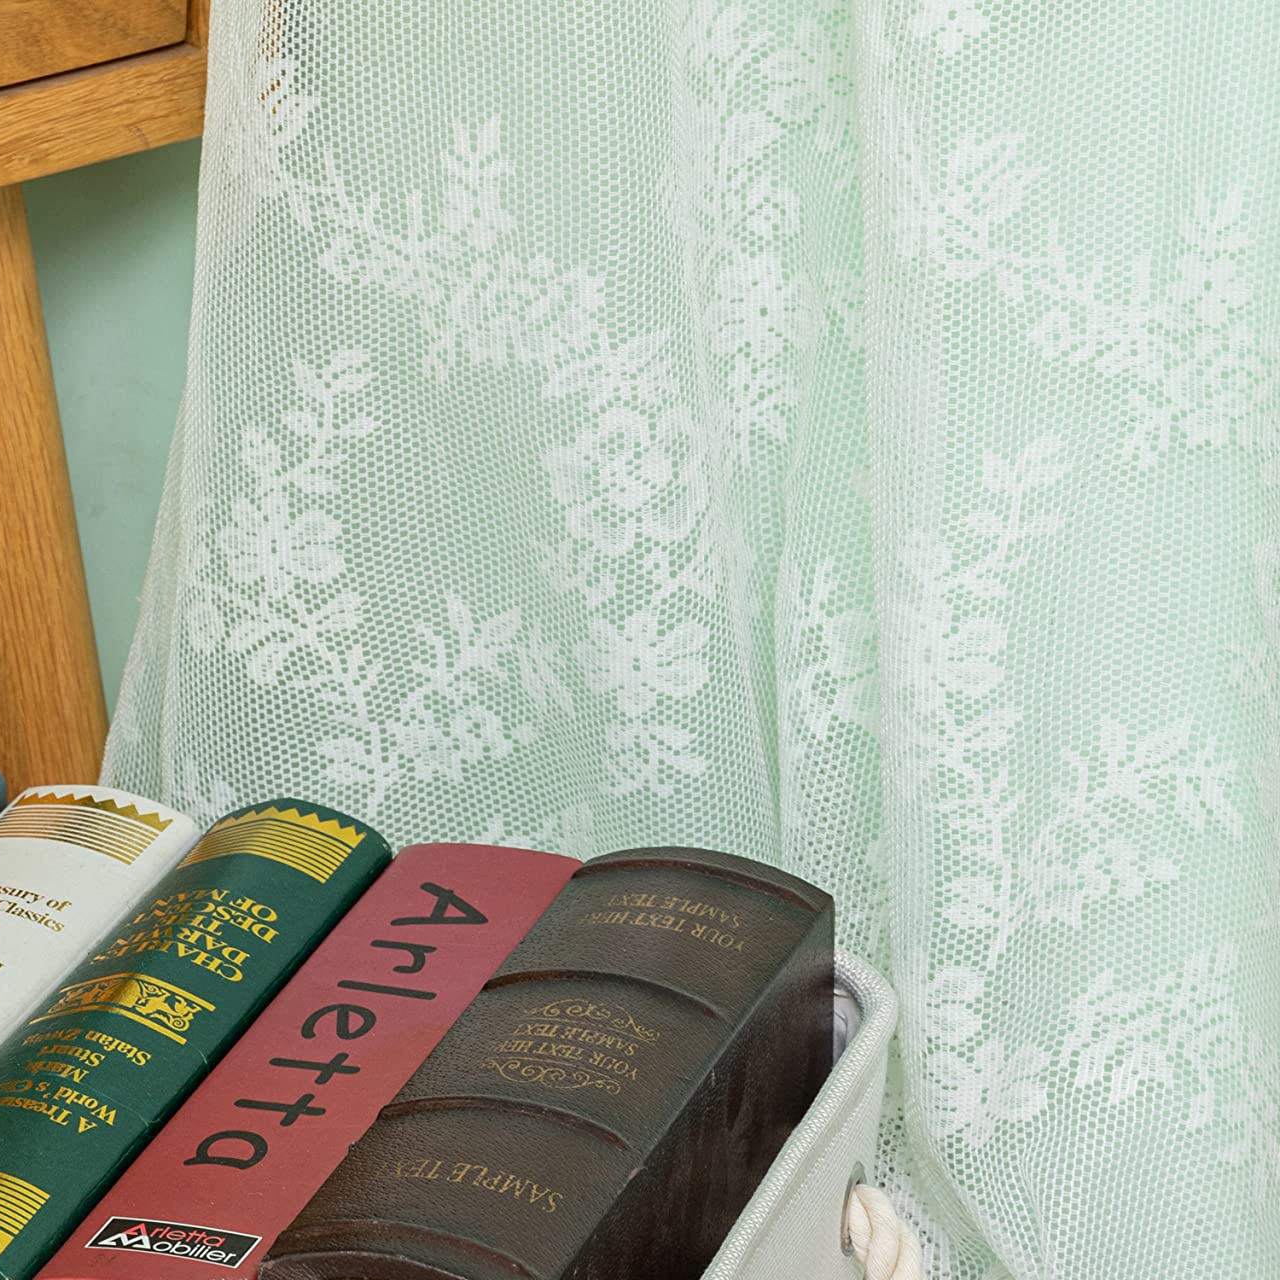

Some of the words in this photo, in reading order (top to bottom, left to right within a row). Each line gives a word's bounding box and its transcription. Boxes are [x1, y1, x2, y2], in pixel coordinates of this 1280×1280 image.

[46, 898, 72, 913] of
[229, 896, 278, 923] OF
[660, 895, 741, 929] SAMPLE
[631, 912, 687, 933] TEXT
[690, 922, 745, 952] YOUR
[182, 881, 489, 1170] Arletta
[84, 1030, 152, 1066] Stafan
[532, 1041, 584, 1060] TEXT
[560, 1026, 640, 1056] SAMPLE
[589, 1051, 640, 1081] YOUR
[77, 1116, 98, 1134] A
[446, 1162, 564, 1213] SAMPLE
[97, 1232, 237, 1264] Mobilier
[121, 1222, 226, 1248] Arletta
